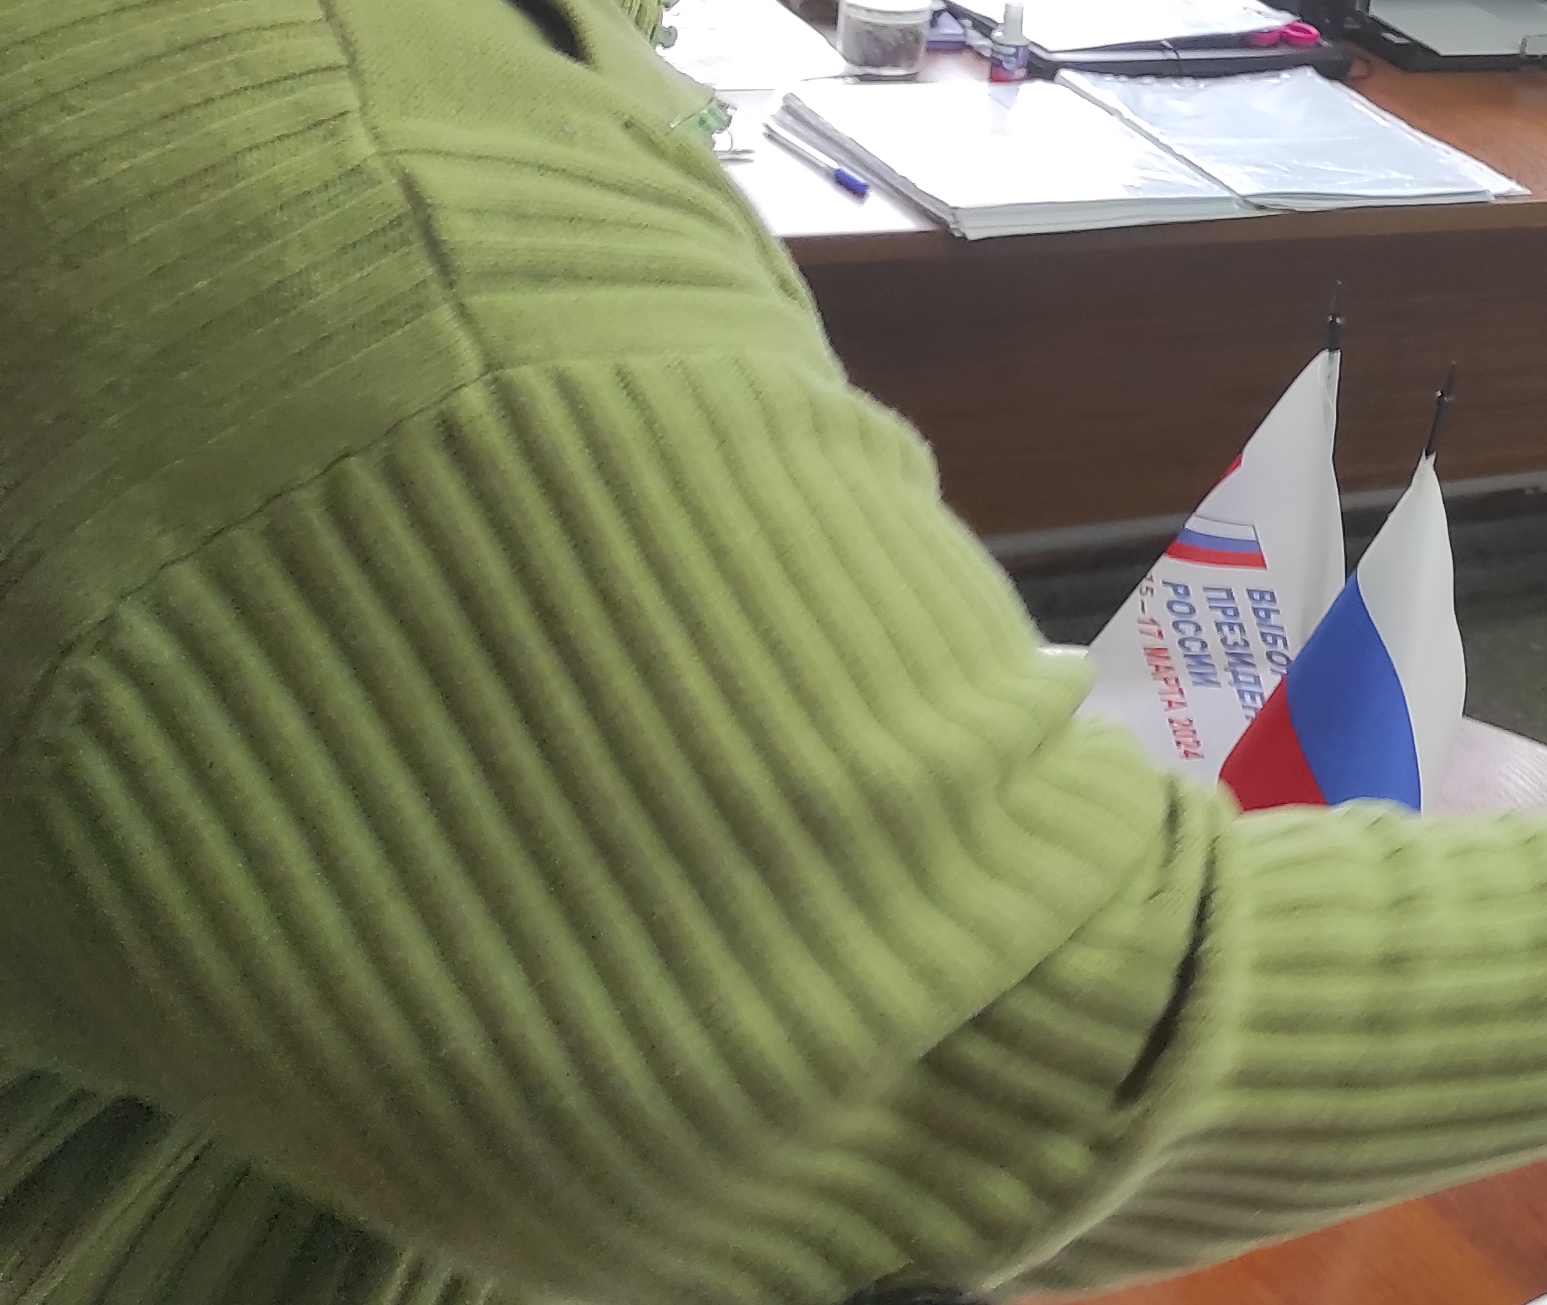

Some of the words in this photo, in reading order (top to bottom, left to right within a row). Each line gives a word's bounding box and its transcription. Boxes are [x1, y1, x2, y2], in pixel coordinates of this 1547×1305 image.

[1162, 580, 1222, 688] РОССИИ
[1143, 647, 1188, 712] МАРТА
[1168, 716, 1205, 761] 2024
